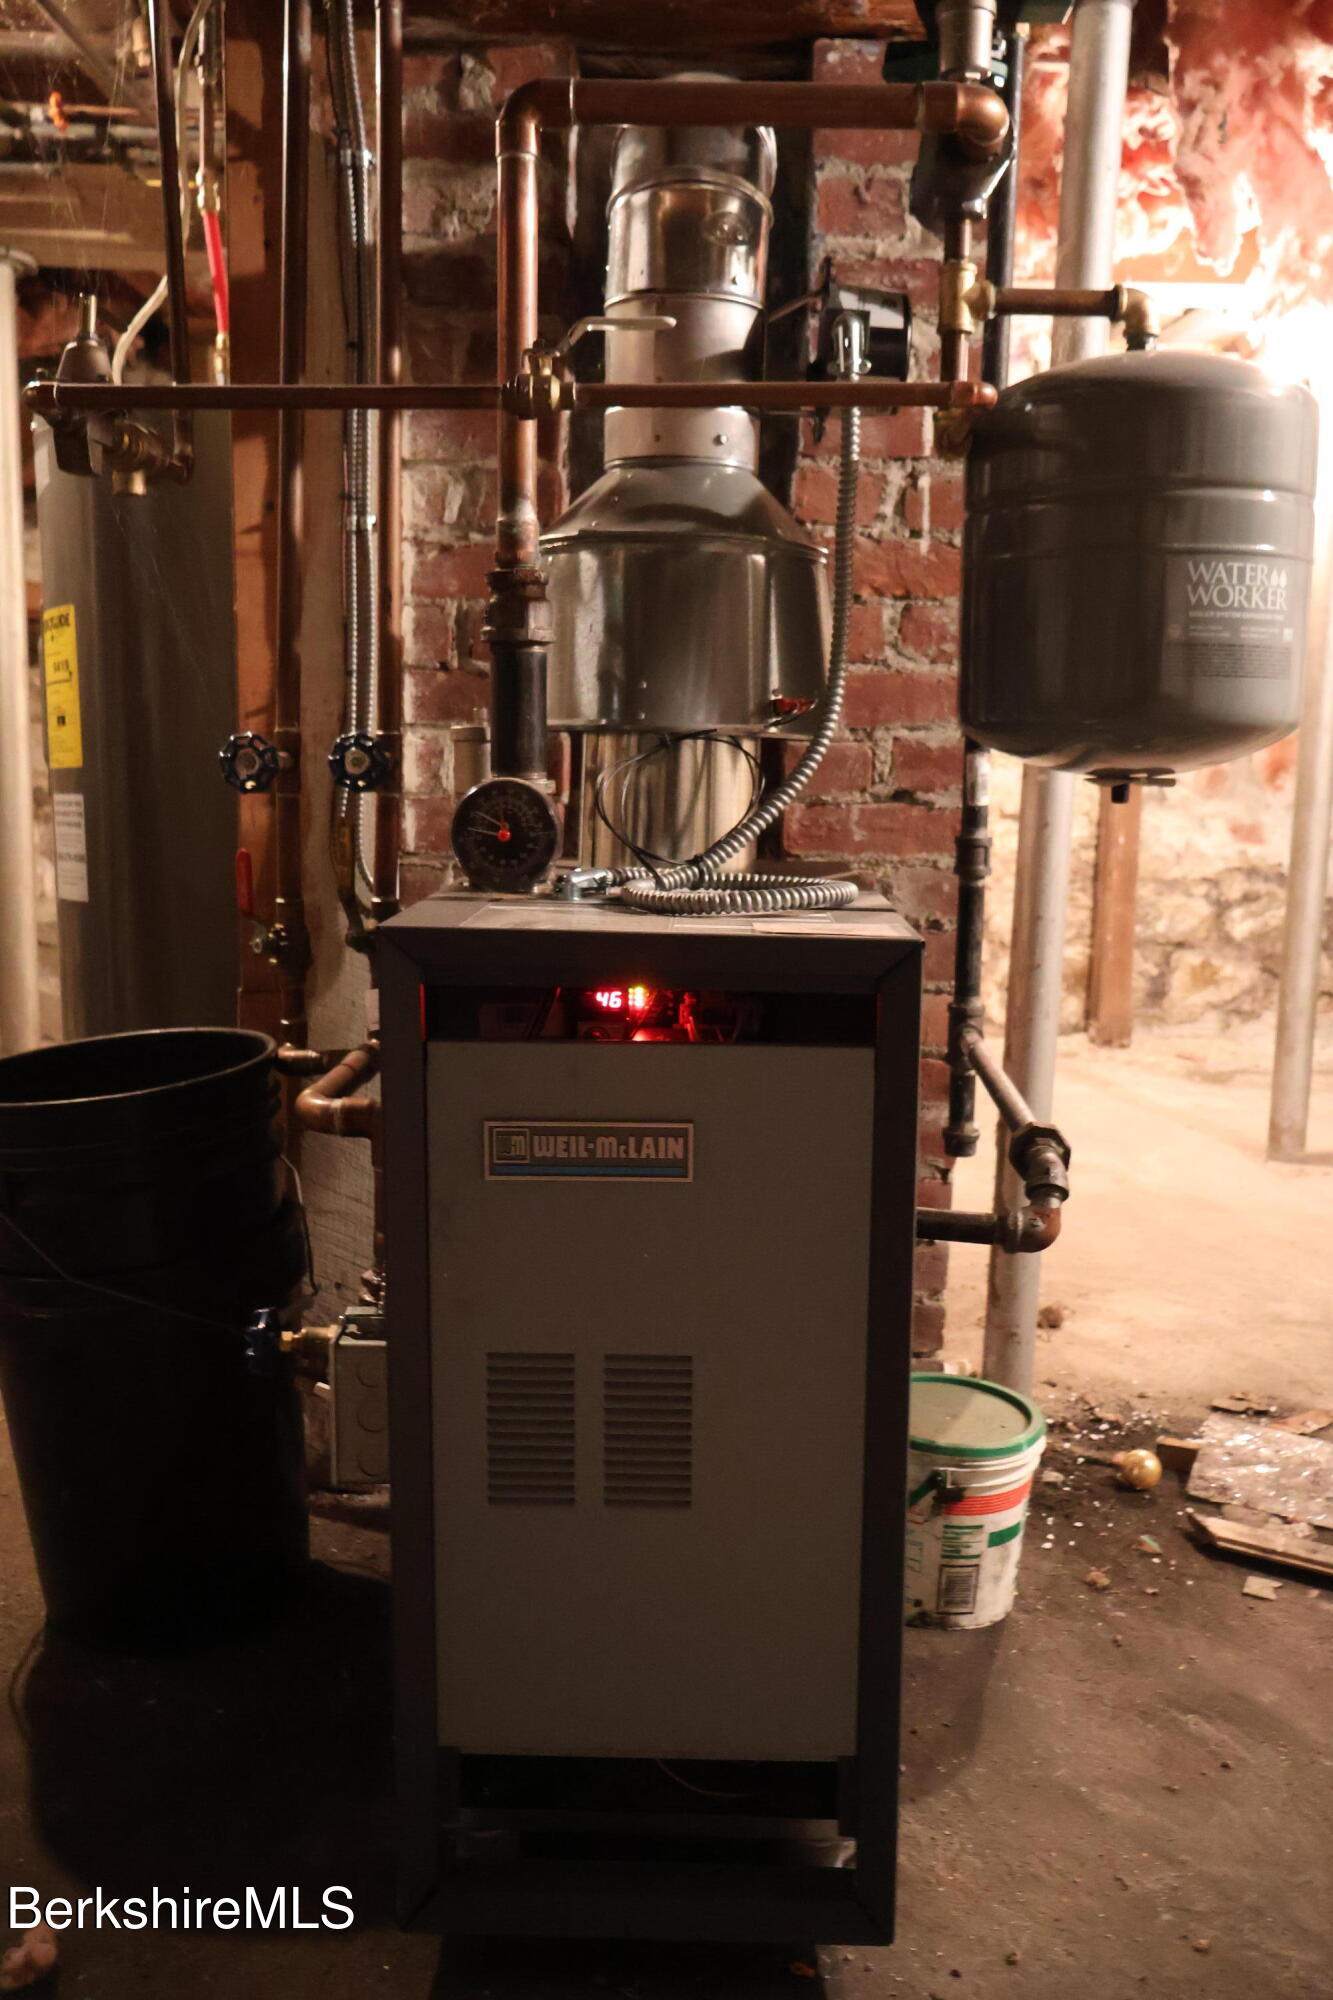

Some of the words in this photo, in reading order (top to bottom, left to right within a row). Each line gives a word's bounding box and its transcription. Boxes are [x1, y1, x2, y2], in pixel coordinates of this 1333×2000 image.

[1187, 561, 1268, 585] WATER
[1187, 584, 1288, 611] WORKER
[595, 990, 622, 1008] 46
